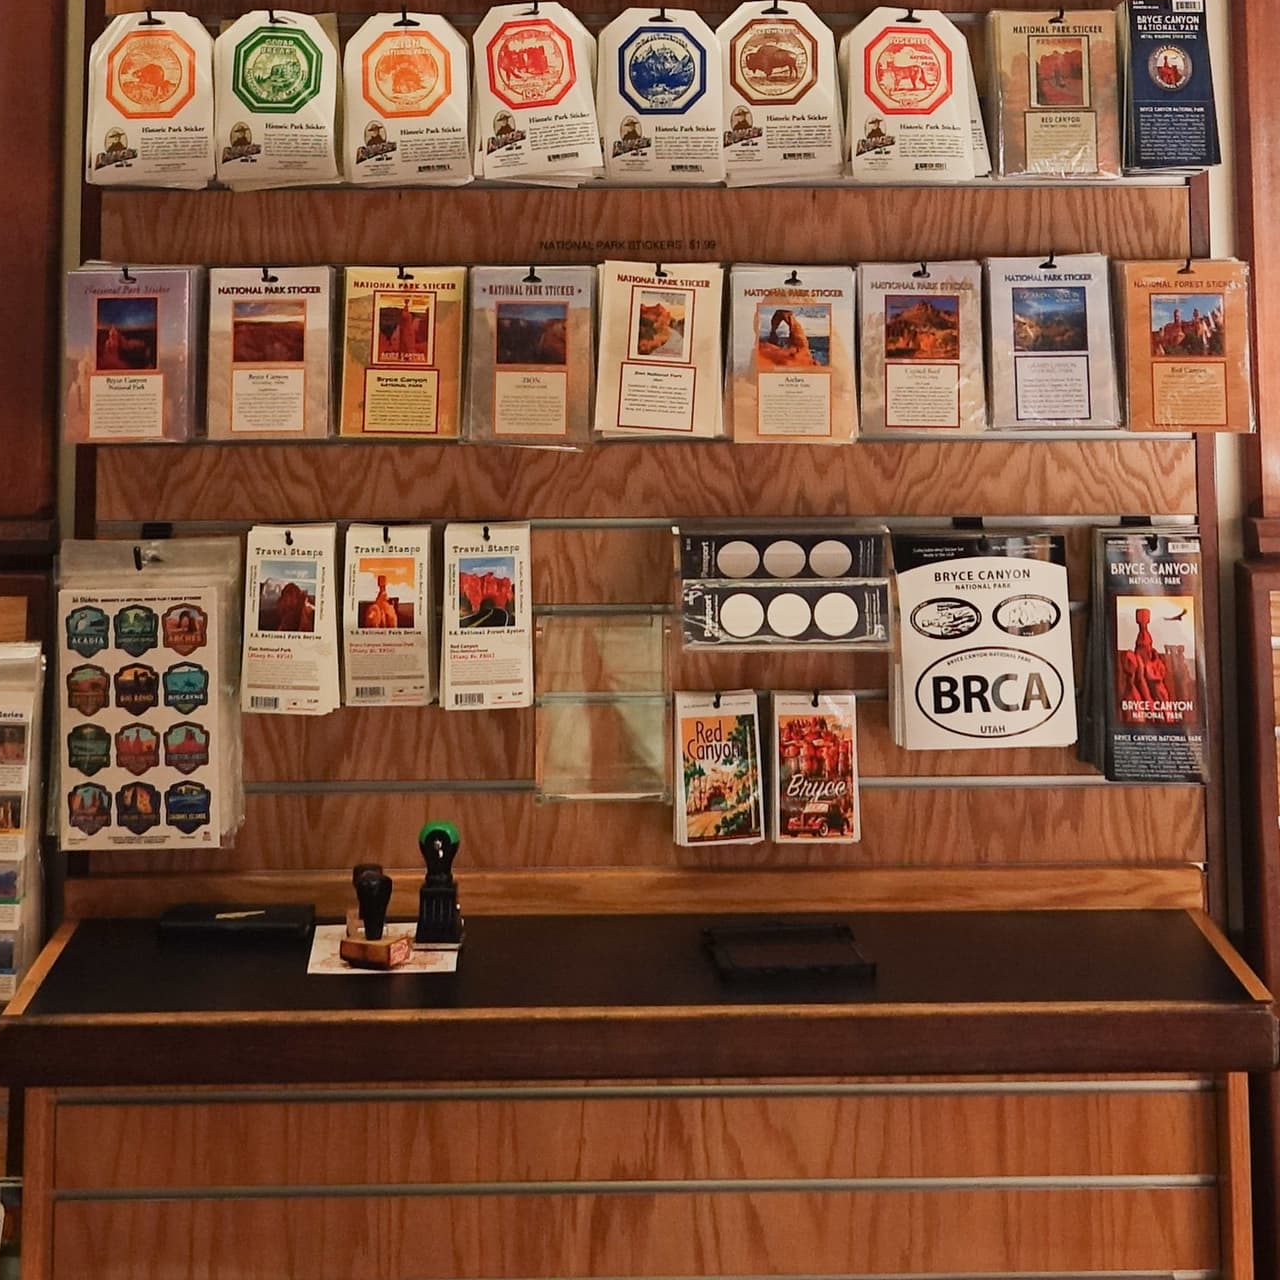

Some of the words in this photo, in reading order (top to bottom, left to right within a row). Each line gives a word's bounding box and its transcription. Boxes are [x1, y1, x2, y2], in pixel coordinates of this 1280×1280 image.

[1136, 15, 1163, 24] BRYCE
[1165, 15, 1200, 24] CANYON
[1012, 25, 1050, 34] NATIONAL
[1052, 25, 1071, 34] PARK
[1073, 25, 1103, 34] STICKER
[528, 115, 552, 124] Historic
[554, 113, 569, 122] Park
[569, 111, 590, 120] Sticker
[807, 113, 828, 121] Sticker
[141, 126, 165, 134] Historic
[167, 125, 182, 133] Park
[265, 122, 288, 130] Historic
[290, 122, 304, 130] Park
[680, 125, 694, 133] Park
[899, 123, 923, 131] Historic
[941, 123, 961, 131] Sticker
[400, 128, 423, 136] Historic
[441, 127, 462, 135] Sticker
[540, 239, 594, 250] NATIONAL
[596, 239, 625, 250] PARK
[628, 239, 682, 250] STICKERS
[617, 273, 657, 285] NATIONAL
[657, 278, 678, 287] PARK
[679, 279, 710, 288] STICKER
[1004, 274, 1043, 282] NATIONAL
[1043, 274, 1062, 282] PARK
[1063, 273, 1092, 281] STICKER
[353, 281, 395, 289] NATIONAL
[398, 282, 420, 290] PARK
[422, 282, 457, 290] STICKER
[870, 281, 915, 290] NATIONAL
[916, 281, 938, 290] PARK
[939, 281, 973, 291] STICKER
[1133, 280, 1172, 288] NATIONAL
[1174, 280, 1204, 288] FOREST
[217, 286, 262, 295] NATIONAL
[264, 286, 286, 294] PARK
[287, 285, 322, 294] STICKER
[488, 284, 523, 296] NATIONAL
[525, 285, 543, 296] PARK
[545, 285, 575, 297] STICKER
[743, 288, 787, 297] NATIONAL
[788, 288, 810, 297] PARK
[811, 288, 844, 297] STICKER
[255, 547, 287, 556] Travel
[290, 547, 323, 559] Stamps
[354, 545, 385, 554] Travel
[388, 545, 421, 556] Stamps
[452, 545, 485, 553] Travel
[487, 544, 520, 555] Stamps
[1110, 562, 1145, 575] BRYCE
[1150, 562, 1198, 575] CANYON
[934, 570, 974, 582] BRYCE
[978, 569, 1031, 580] CANYON
[1128, 577, 1162, 585] NATIONAL
[1164, 577, 1181, 585] PARK
[71, 637, 105, 645] ACADIA
[931, 672, 1052, 714] BRCA
[1121, 700, 1150, 711] BRYCE
[1153, 700, 1193, 711] CANYON
[1132, 711, 1165, 719] NATIONAL
[1166, 711, 1183, 719] PARK
[695, 719, 723, 744] Red
[980, 724, 1006, 734] UTAH
[1158, 734, 1187, 742] NATIONAL
[1188, 734, 1202, 742] PARK
[687, 739, 741, 763] Canyon
[786, 773, 848, 803] Bryce
